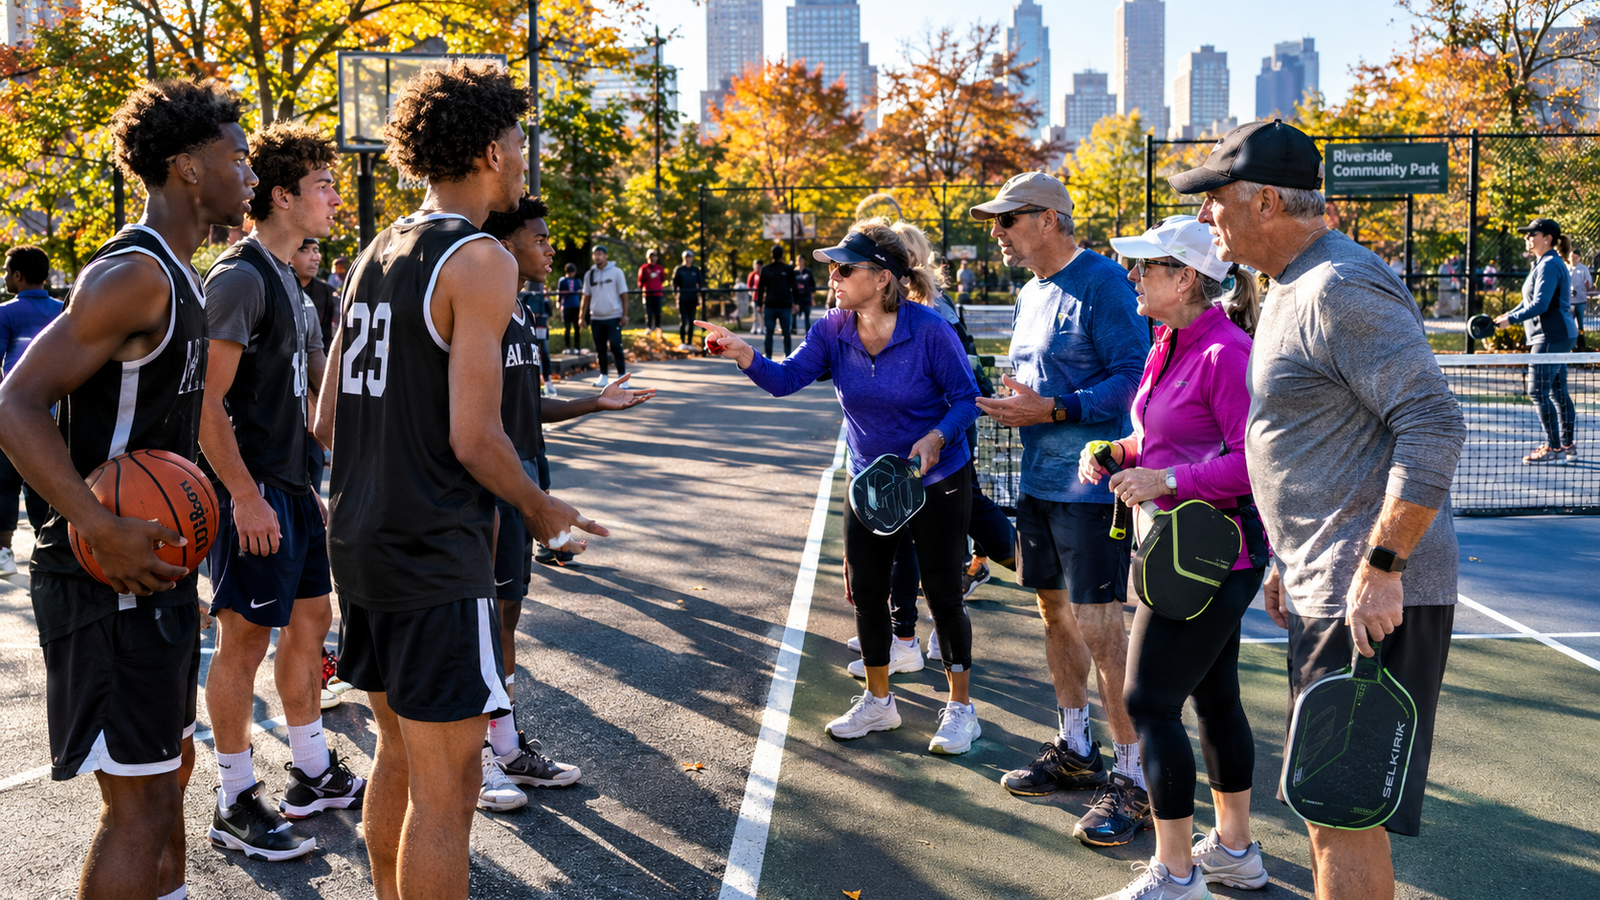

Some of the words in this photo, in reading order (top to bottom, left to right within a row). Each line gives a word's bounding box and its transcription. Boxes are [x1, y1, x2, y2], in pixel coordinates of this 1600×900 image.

[1333, 149, 1393, 162] Riverside
[1333, 163, 1407, 178] Community
[1410, 162, 1440, 175] Park
[342, 302, 392, 397] 23
[1382, 721, 1406, 798] SELKIRIK
